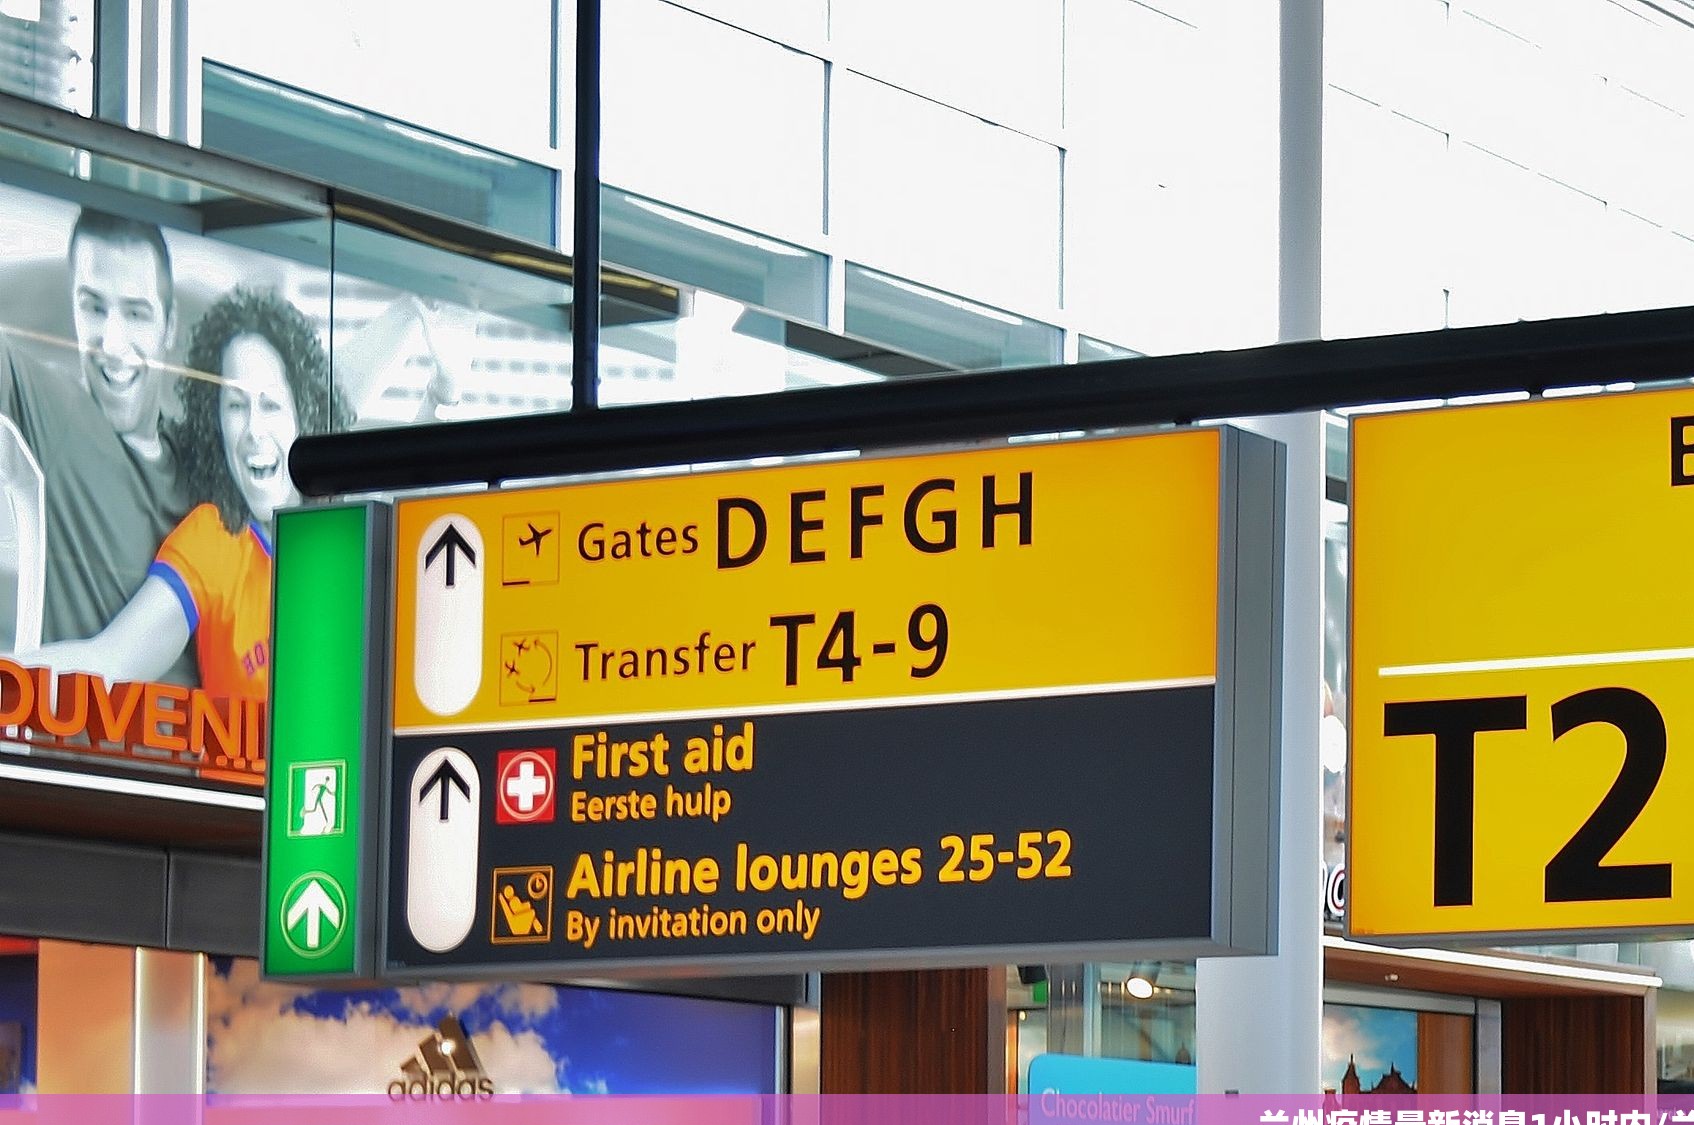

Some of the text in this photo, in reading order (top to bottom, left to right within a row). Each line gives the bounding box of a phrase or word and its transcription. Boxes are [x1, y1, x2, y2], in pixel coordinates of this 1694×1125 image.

[576, 520, 700, 562] Gates
[574, 602, 950, 687] Transfer T4-9
[572, 721, 755, 781] First aid
[570, 781, 733, 824] Eerste hulp
[565, 829, 1073, 901] Airline lounges 25-52
[566, 899, 822, 949] By invitation only
[388, 1078, 494, 1102] adidas
[1041, 1087, 1195, 1125] Chocolatier Smurf
